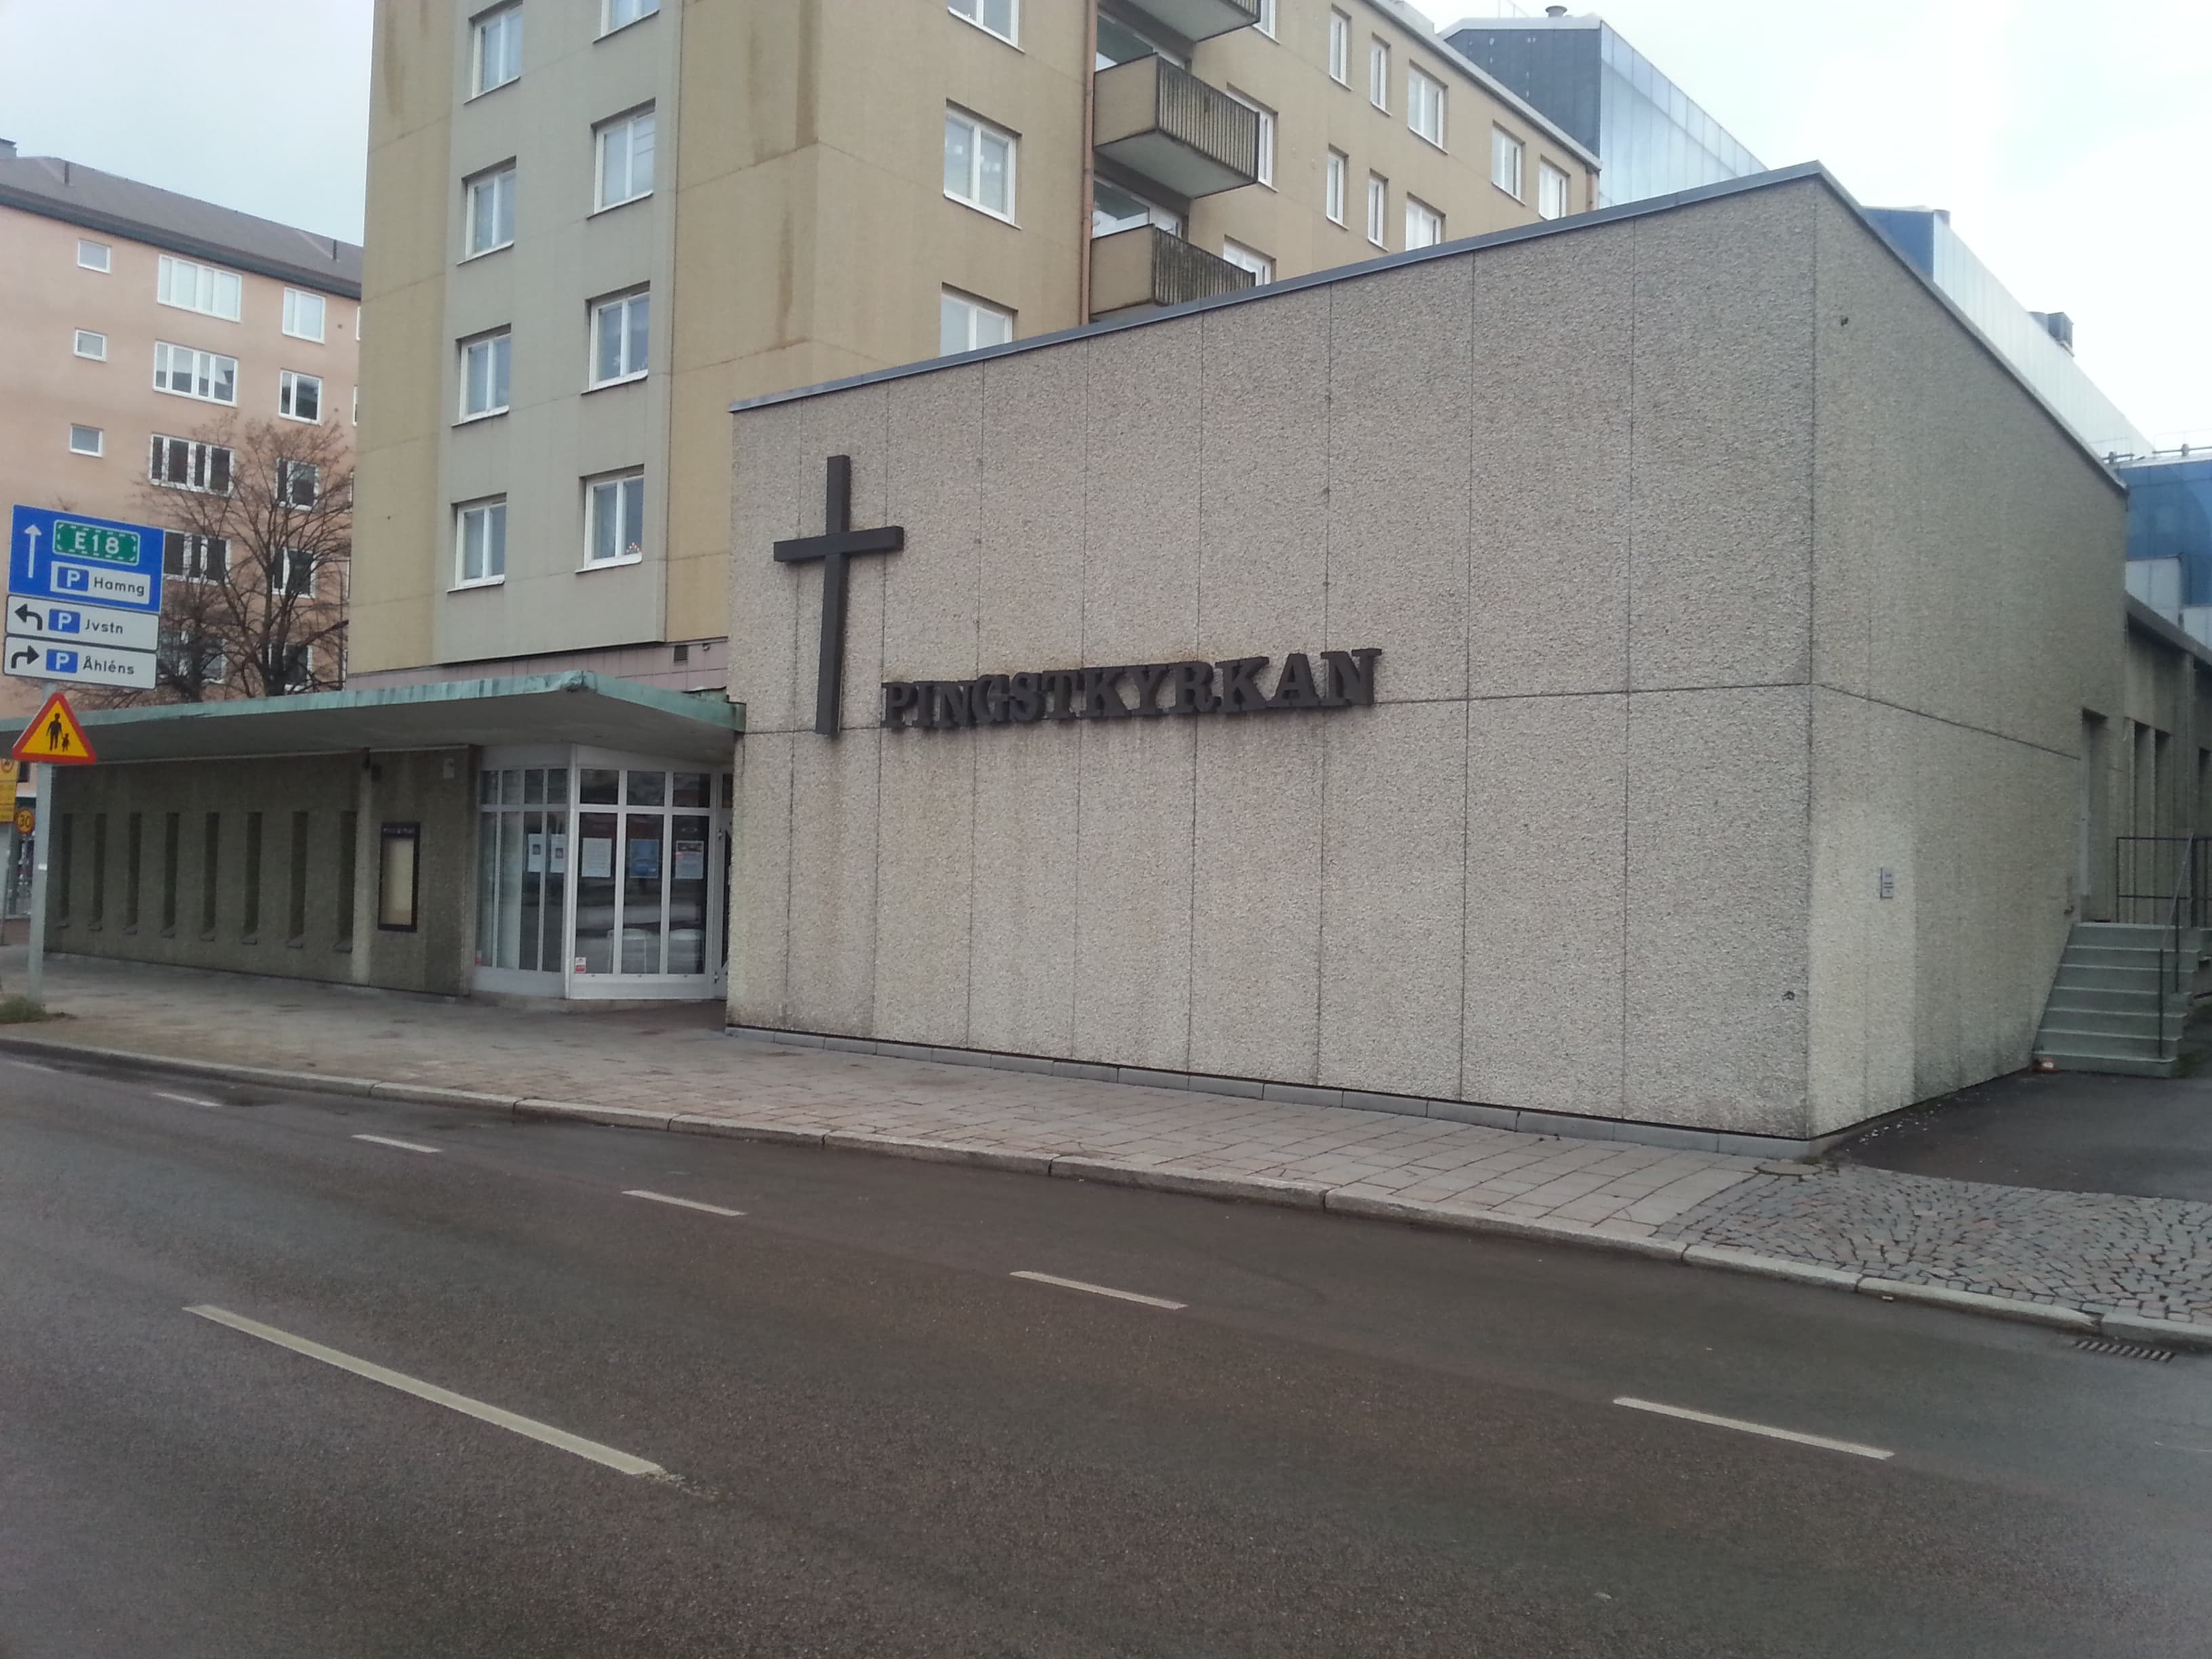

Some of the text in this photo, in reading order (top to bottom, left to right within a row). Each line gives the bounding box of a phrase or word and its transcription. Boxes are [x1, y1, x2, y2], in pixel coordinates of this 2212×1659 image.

[75, 532, 119, 554] E18
[67, 570, 144, 597] P Hamng
[58, 613, 123, 634] P Jvstn
[56, 652, 135, 675] P Åhléns
[881, 648, 1382, 729] PINGSTKYRKAN
[18, 814, 31, 828] 30
